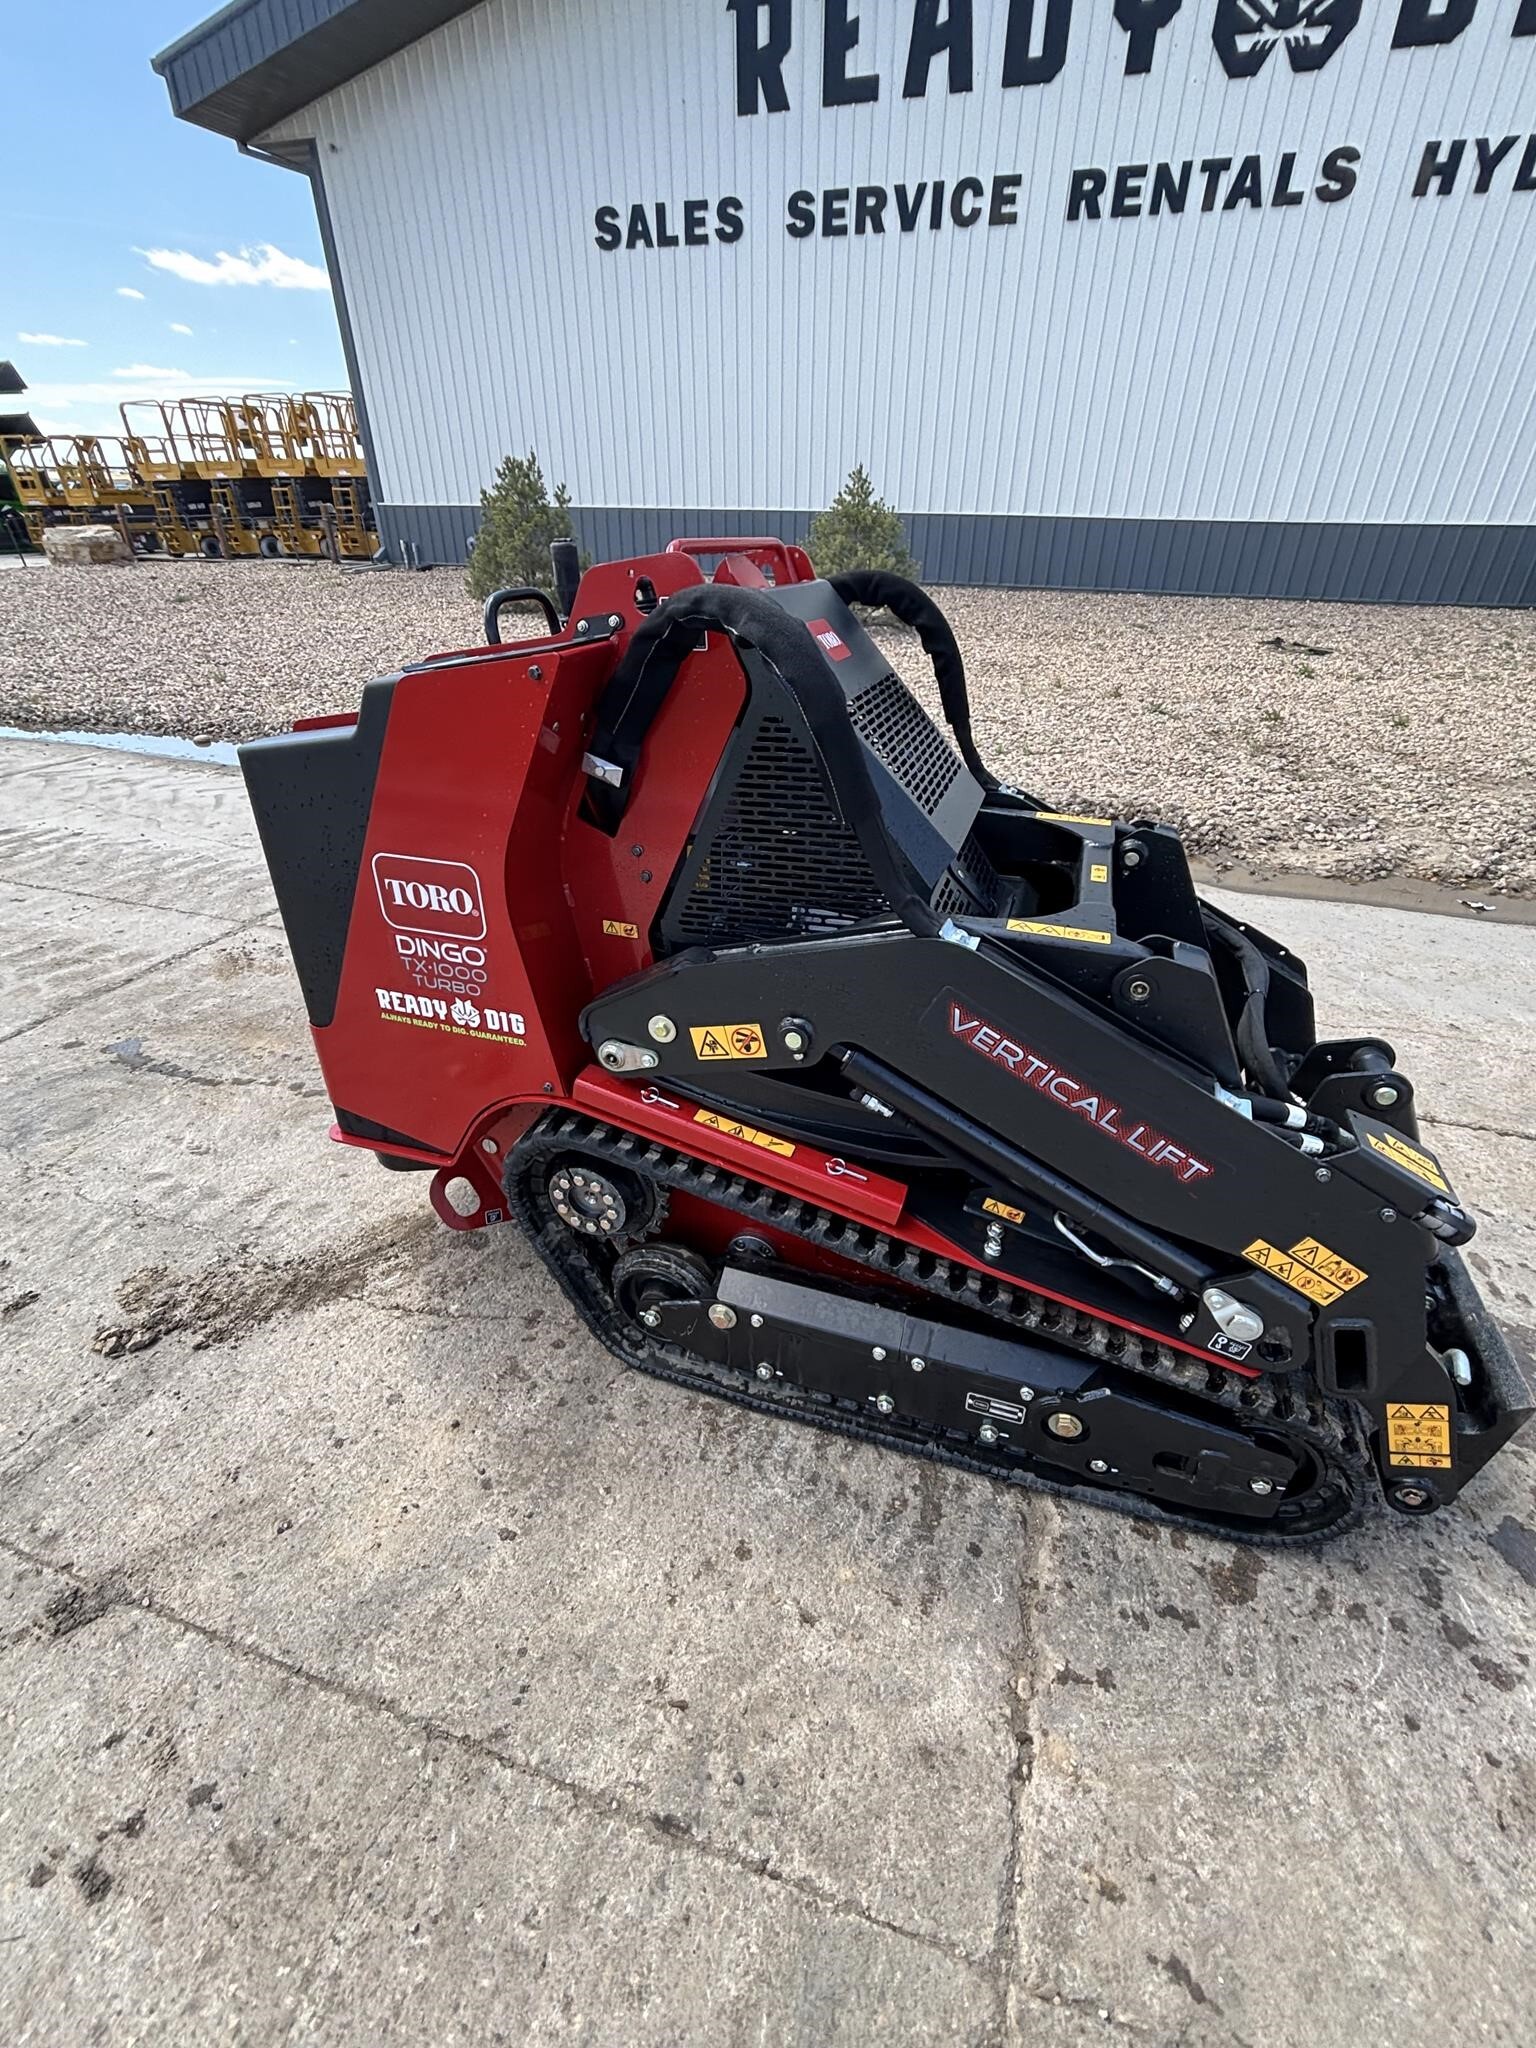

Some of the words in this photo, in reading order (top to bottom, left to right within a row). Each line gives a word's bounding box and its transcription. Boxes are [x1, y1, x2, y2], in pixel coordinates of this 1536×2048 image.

[594, 195, 744, 250] SALES
[786, 174, 1022, 239] SERVICE
[1067, 146, 1362, 221] RENTALS
[384, 878, 474, 916] TORO
[395, 934, 486, 967] DINGO
[412, 973, 481, 996] TURBO
[375, 988, 448, 1020] READY
[484, 1008, 526, 1035] DIG
[381, 1012, 412, 1025] ALWAYS
[413, 1017, 438, 1029] READY
[440, 1023, 451, 1032] TO
[470, 1030, 527, 1047] GUARANTEED.
[951, 1005, 1121, 1135] VERTICAL
[1126, 1125, 1212, 1181] LIFT
